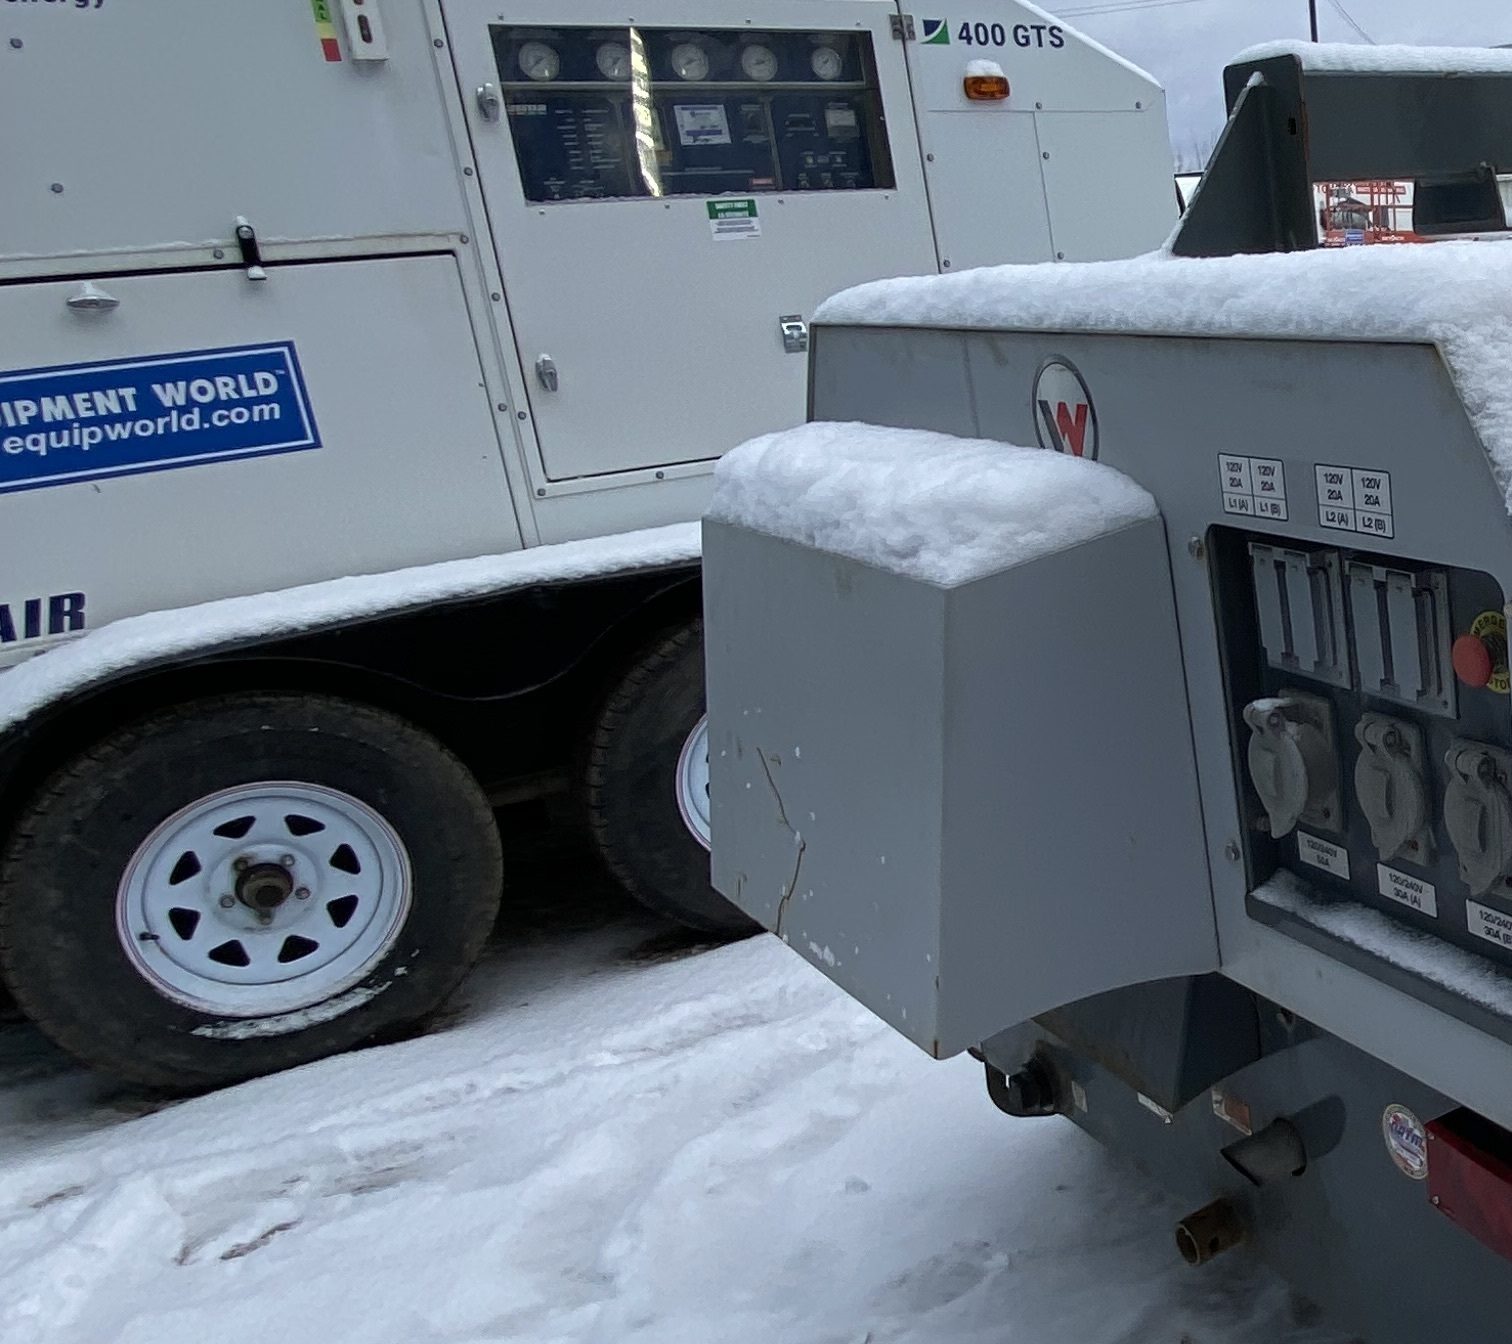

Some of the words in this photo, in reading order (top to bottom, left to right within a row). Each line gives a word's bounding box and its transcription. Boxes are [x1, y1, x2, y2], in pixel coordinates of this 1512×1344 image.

[958, 22, 1006, 47] 400
[1013, 24, 1065, 48] GTS
[3, 402, 281, 455] equipworld.com
[1324, 472, 1344, 485] 120V
[1361, 477, 1381, 490] 120V
[1328, 489, 1343, 501] 20A
[1365, 494, 1380, 507] 20A
[1326, 511, 1336, 522] L2
[1338, 512, 1349, 526] (A)
[1362, 516, 1373, 528] L2
[1375, 518, 1386, 533] (B)
[1389, 872, 1424, 894] 120/240V
